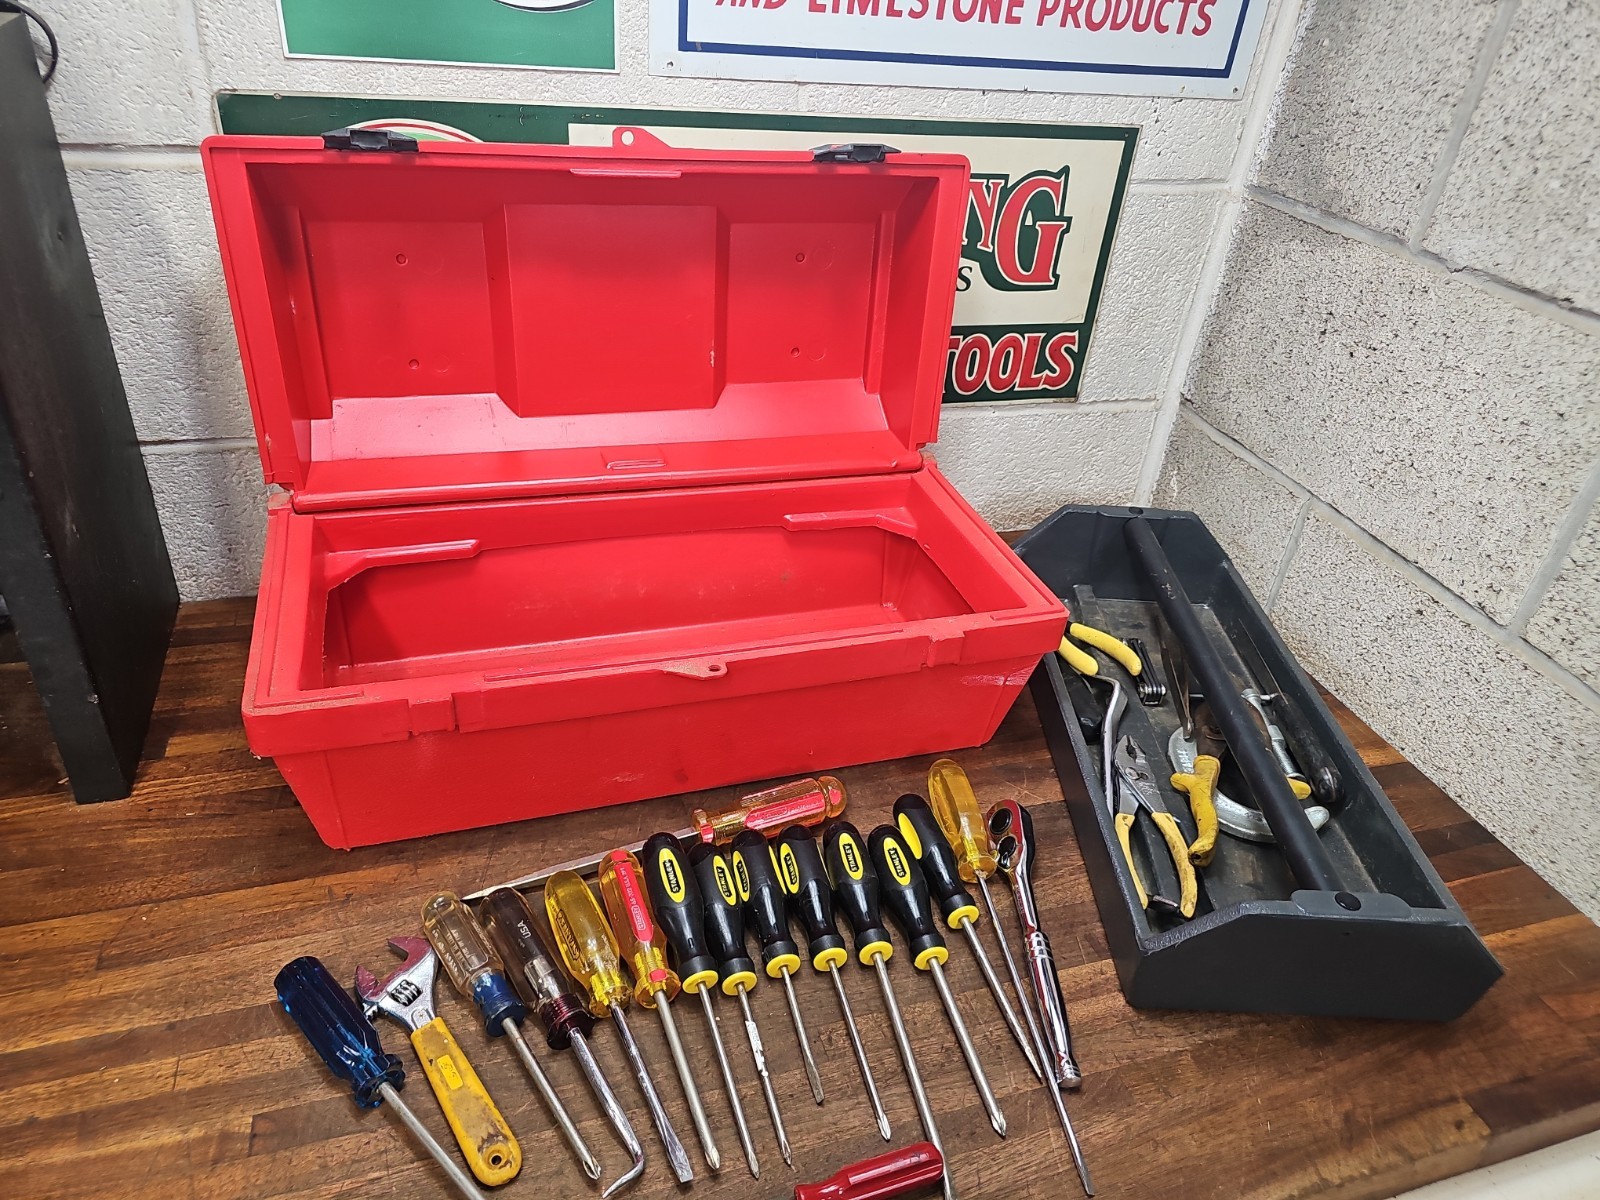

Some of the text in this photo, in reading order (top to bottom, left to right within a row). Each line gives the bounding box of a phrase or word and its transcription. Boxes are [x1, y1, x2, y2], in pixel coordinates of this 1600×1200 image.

[1036, 0, 1217, 36] PRODUCTS
[844, 844, 859, 872] STANLEY
[888, 848, 906, 878] STANLEY
[664, 859, 680, 893] STANLEY
[517, 919, 532, 939] USA
